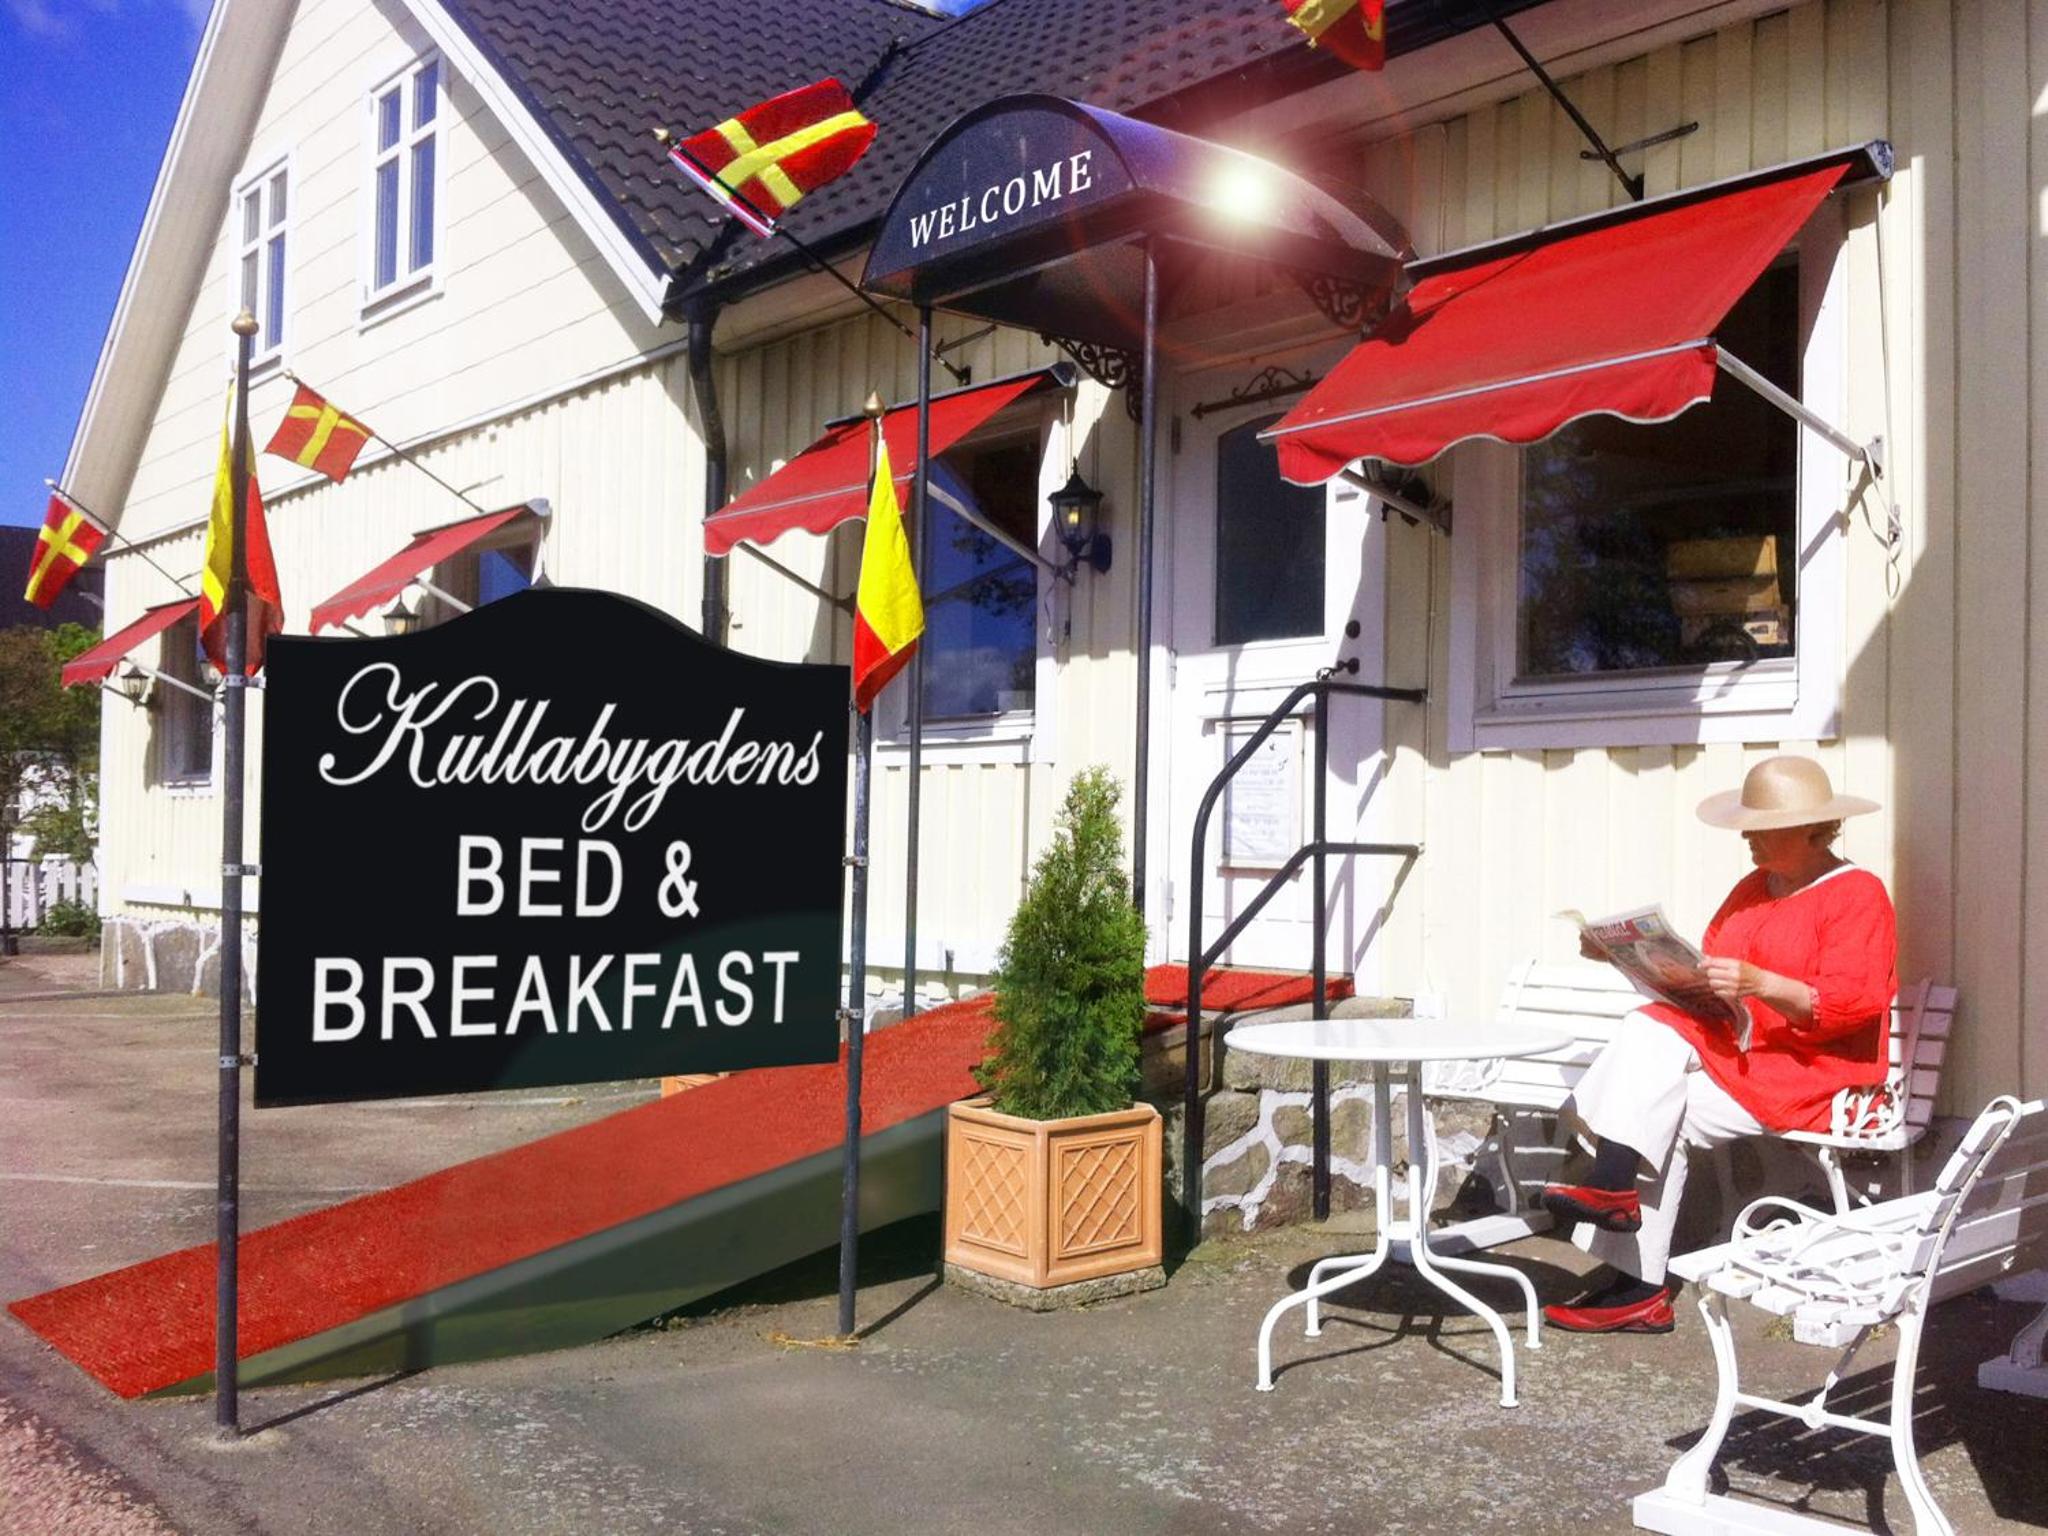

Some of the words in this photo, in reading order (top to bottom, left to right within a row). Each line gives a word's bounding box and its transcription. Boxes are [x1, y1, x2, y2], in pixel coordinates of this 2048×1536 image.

[909, 150, 1092, 249] WELCOME
[319, 661, 824, 833] Kullabygdens
[456, 835, 623, 917] BED
[657, 840, 701, 918] &
[312, 950, 801, 1042] BREAKFAST
